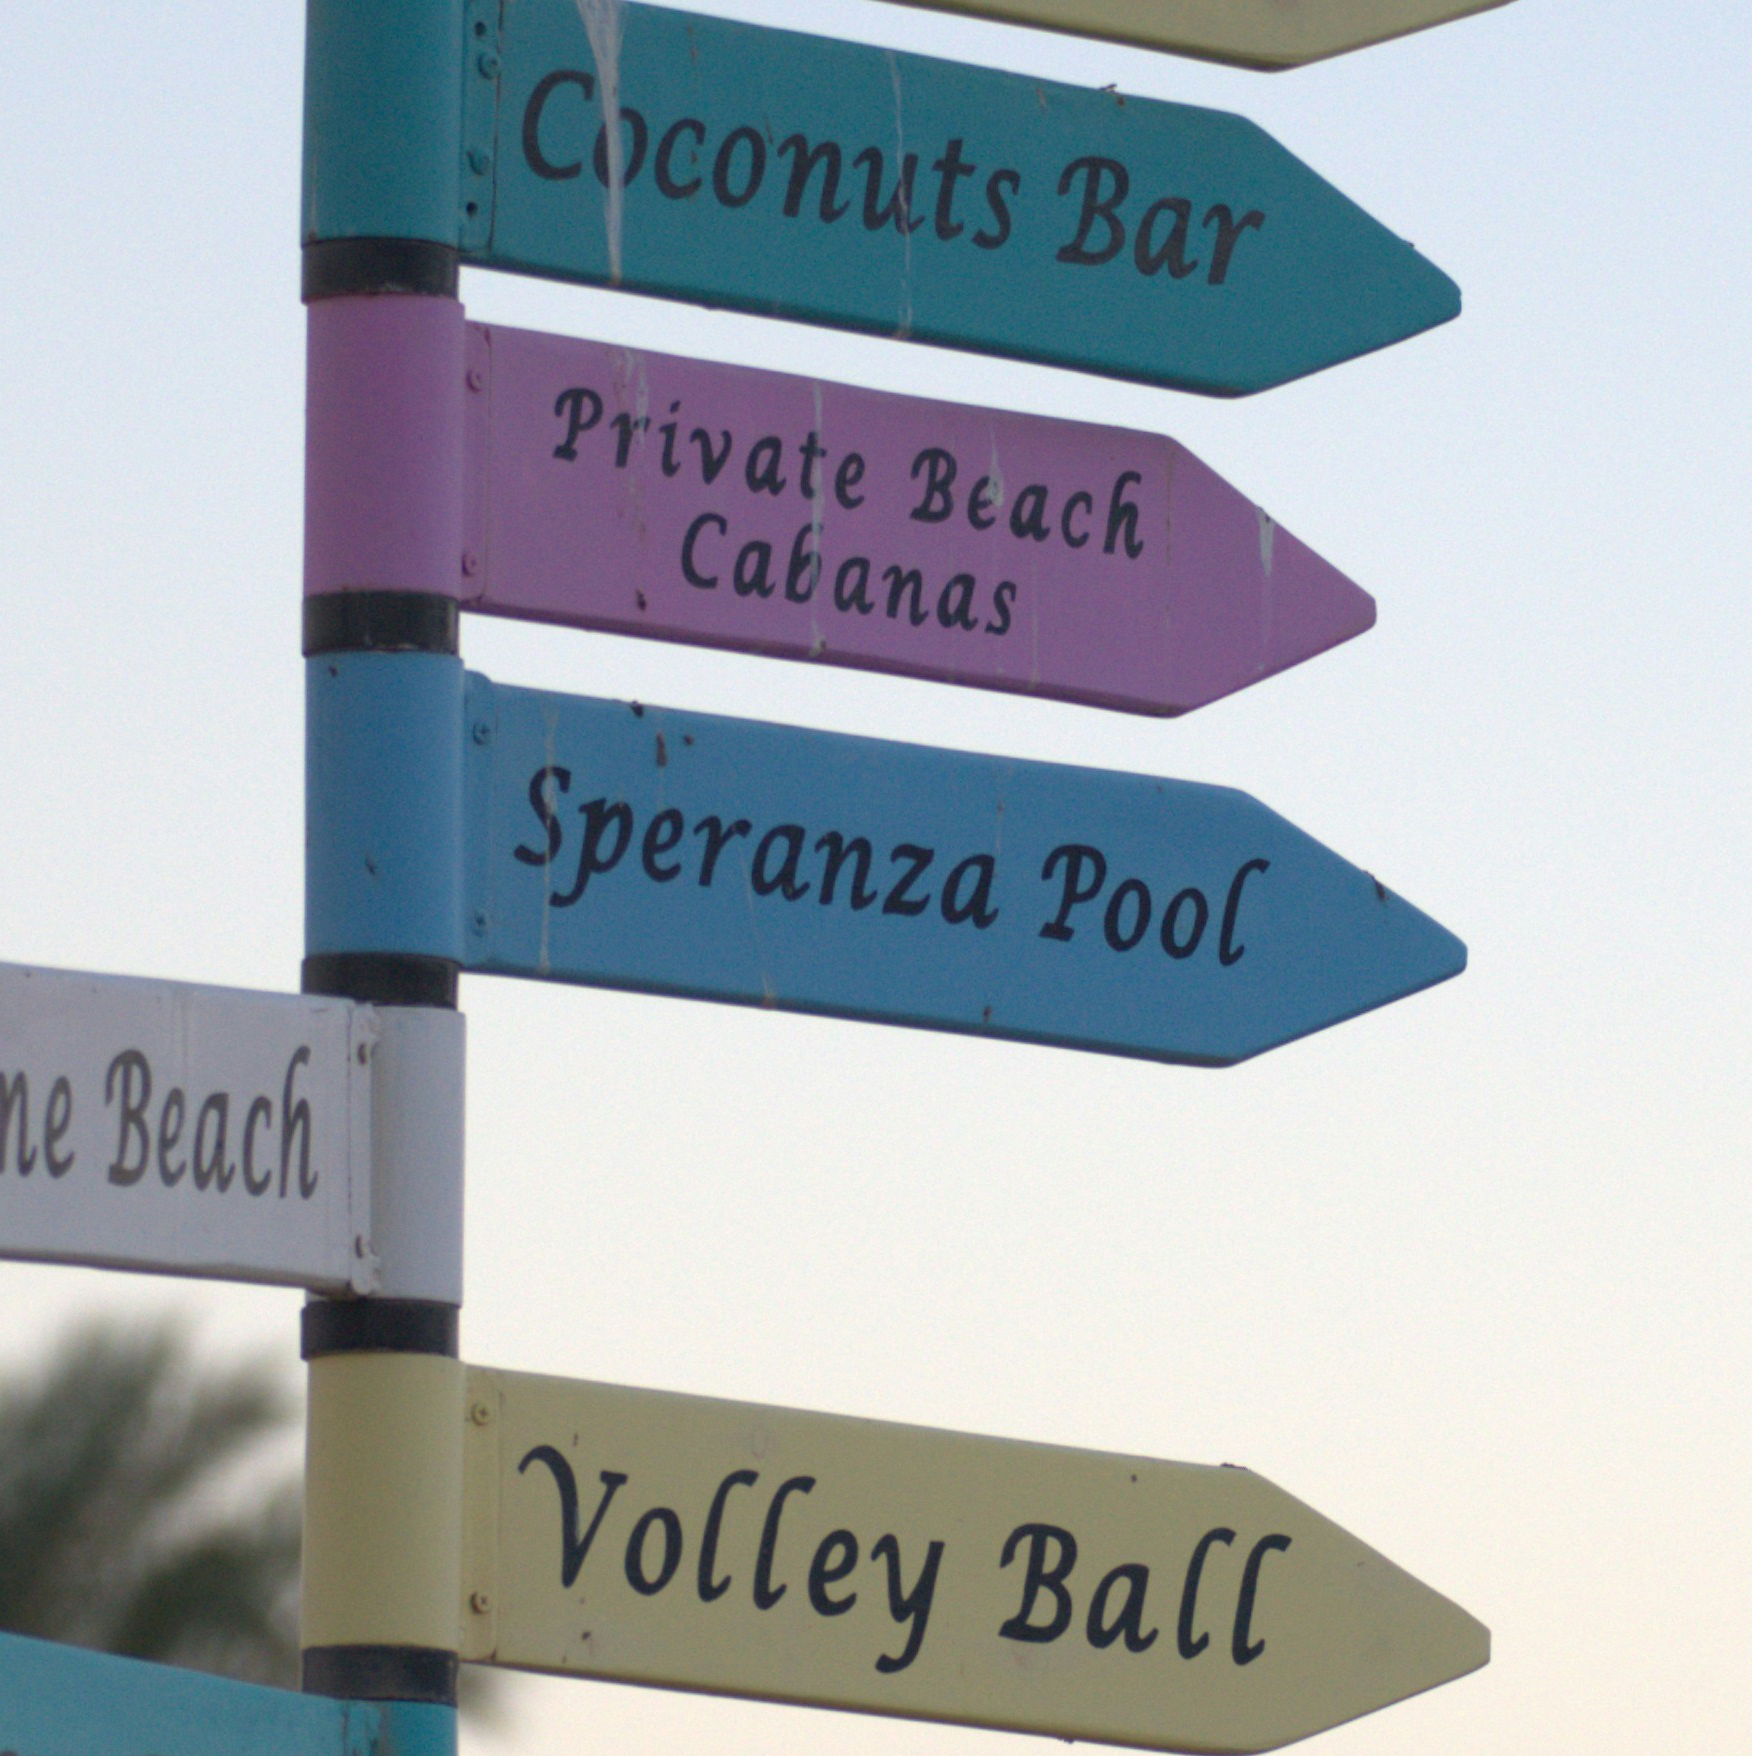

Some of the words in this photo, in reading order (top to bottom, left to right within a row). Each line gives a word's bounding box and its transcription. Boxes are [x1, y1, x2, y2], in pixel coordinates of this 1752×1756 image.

[522, 70, 1021, 249] Coconuts
[1056, 156, 1265, 285] Bar
[553, 388, 865, 509] Private
[910, 447, 1143, 559] Beach
[678, 513, 1017, 636] Cabanas
[514, 765, 998, 929] Speranza
[1040, 844, 1270, 966] Pool
[105, 1045, 318, 1199] Beach
[517, 1448, 947, 1673] Volley
[999, 1523, 1292, 1666] Ball
